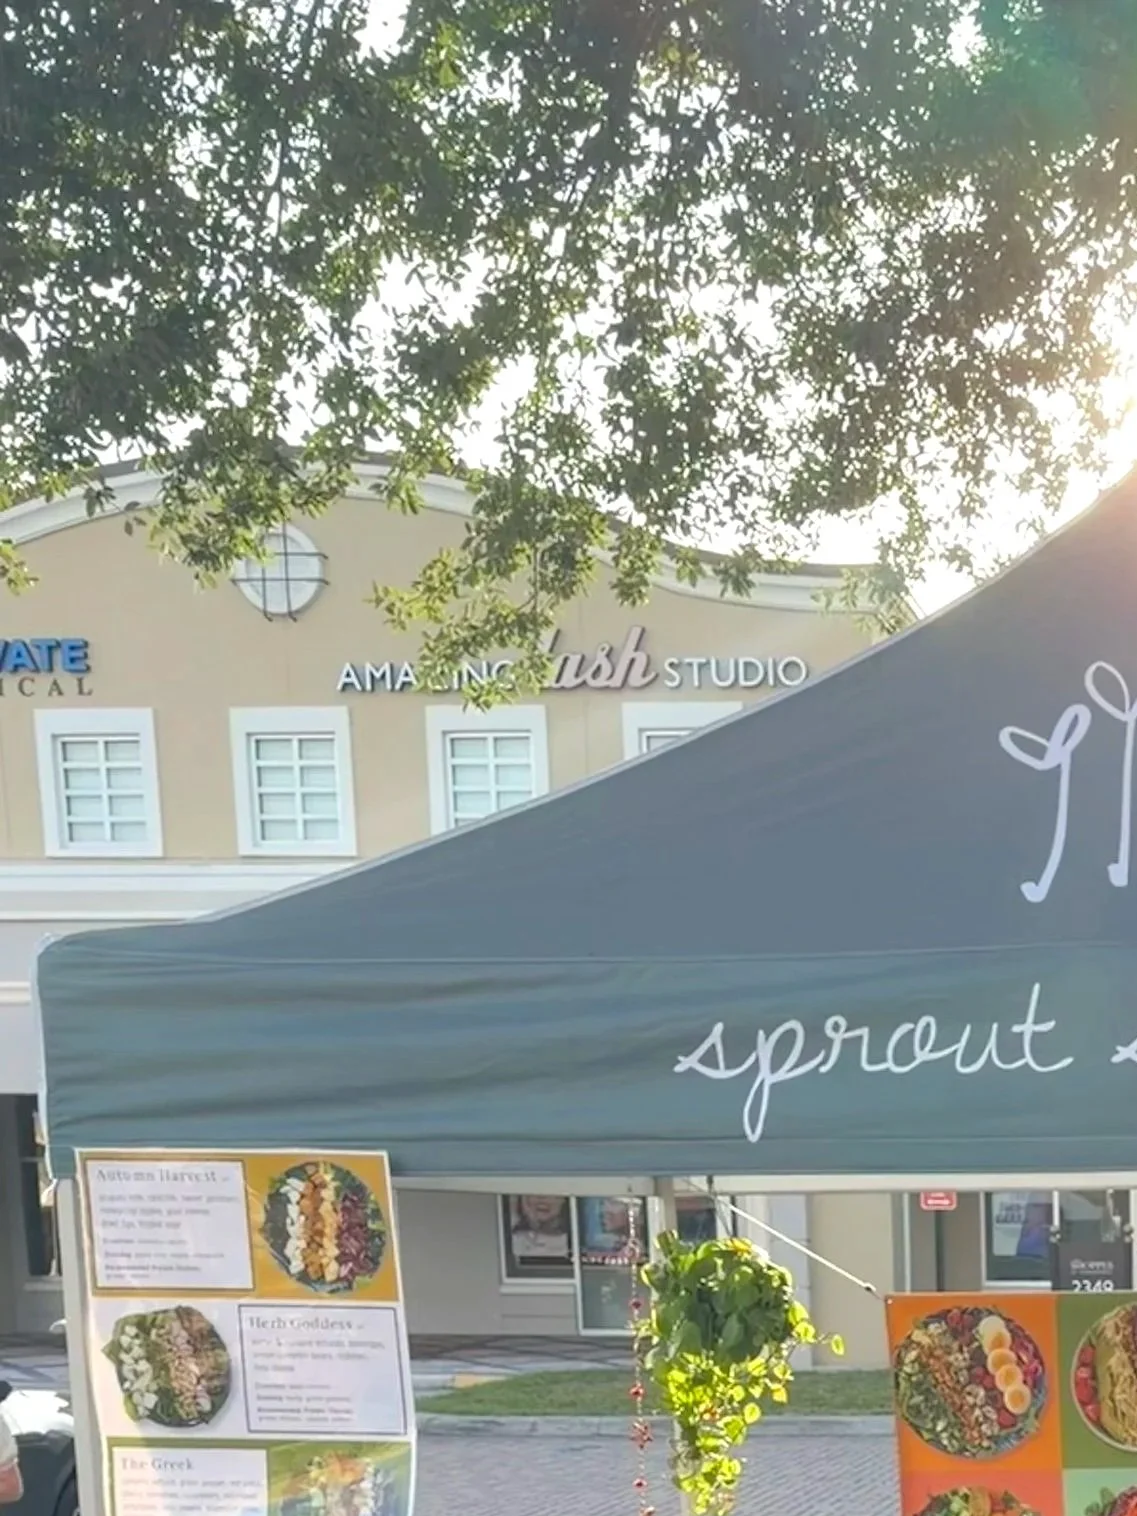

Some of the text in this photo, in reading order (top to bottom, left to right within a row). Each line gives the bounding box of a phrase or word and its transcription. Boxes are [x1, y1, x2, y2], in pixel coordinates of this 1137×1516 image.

[663, 655, 810, 688] STUDIO
[673, 982, 1074, 1143] sprout
[96, 1168, 155, 1183] Autumn
[159, 1168, 217, 1184] Harvest
[249, 1315, 286, 1330] Herb
[289, 1316, 354, 1331] Goddess
[121, 1457, 194, 1471] The Greek
